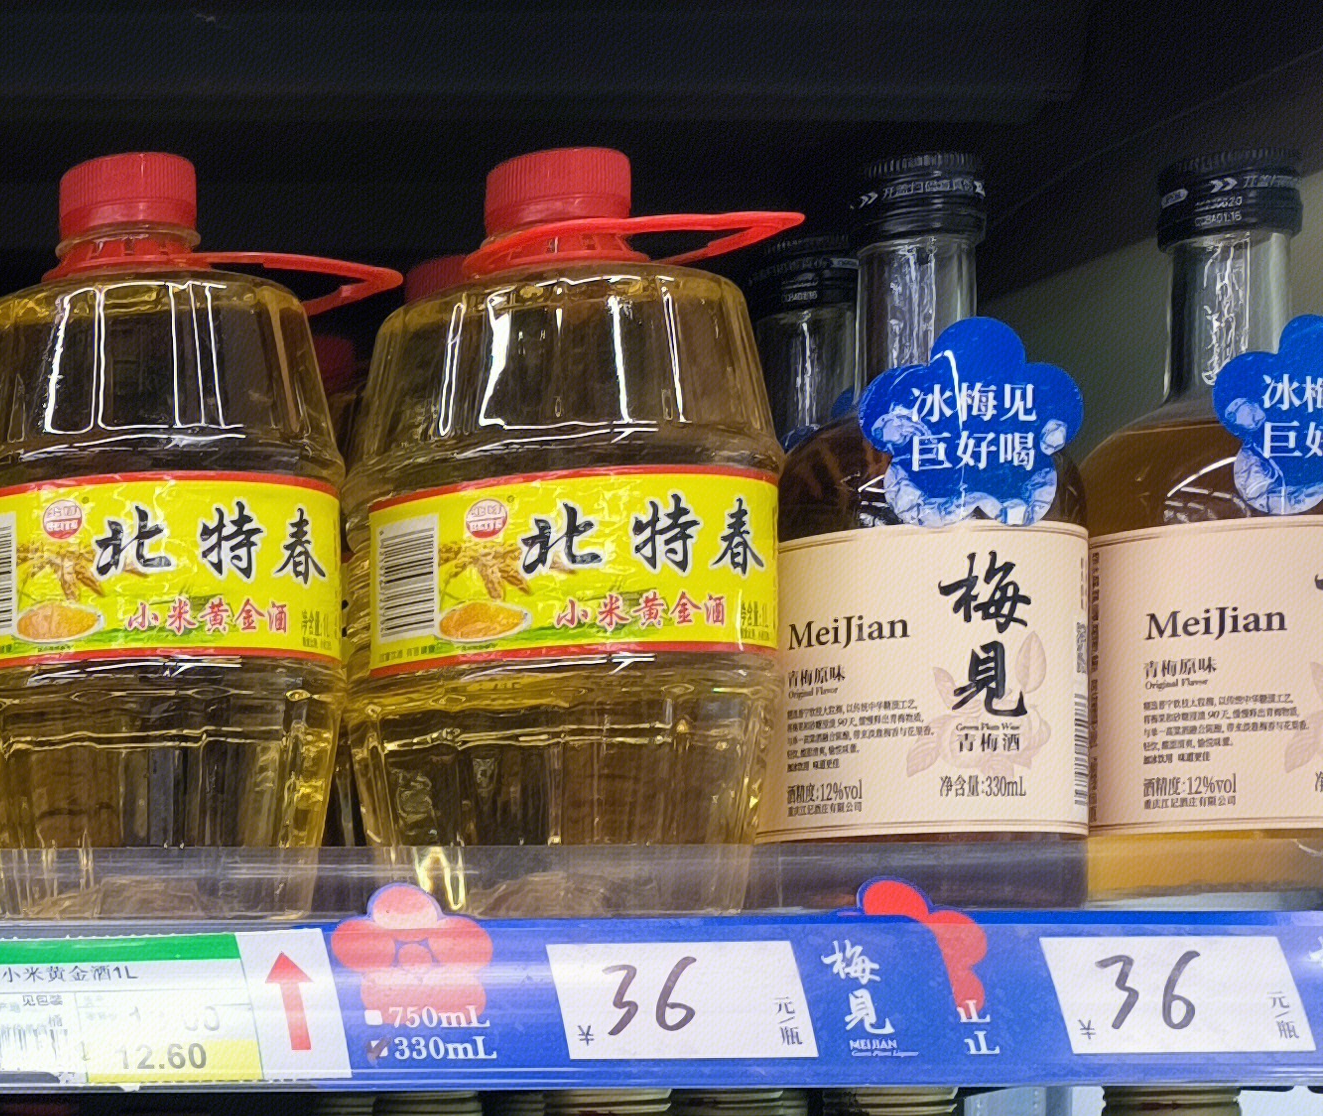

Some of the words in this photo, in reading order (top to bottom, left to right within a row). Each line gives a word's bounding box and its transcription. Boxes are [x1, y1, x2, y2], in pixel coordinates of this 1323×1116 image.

[911, 383, 1037, 423] 冰梅见
[911, 431, 1036, 473] 巨好喝
[96, 500, 327, 585] 北特春
[520, 493, 765, 576] 北特春
[126, 599, 289, 634] 小米黄金酒
[556, 591, 726, 628] 小米黄金酒
[1144, 606, 1287, 641] MeiJian
[787, 613, 910, 650] MeiJian
[787, 664, 846, 688] 青梅原味
[1143, 656, 1218, 679] 青梅原味
[1145, 678, 1179, 690] Original
[957, 733, 1020, 753] 青梅酒
[939, 774, 1027, 798] 净含量:330mL
[602, 956, 698, 1036] 36
[1095, 950, 1201, 1030] 36
[389, 1007, 490, 1028] 750mL
[117, 1042, 208, 1070] 12.60
[393, 1036, 497, 1059] 330mL
